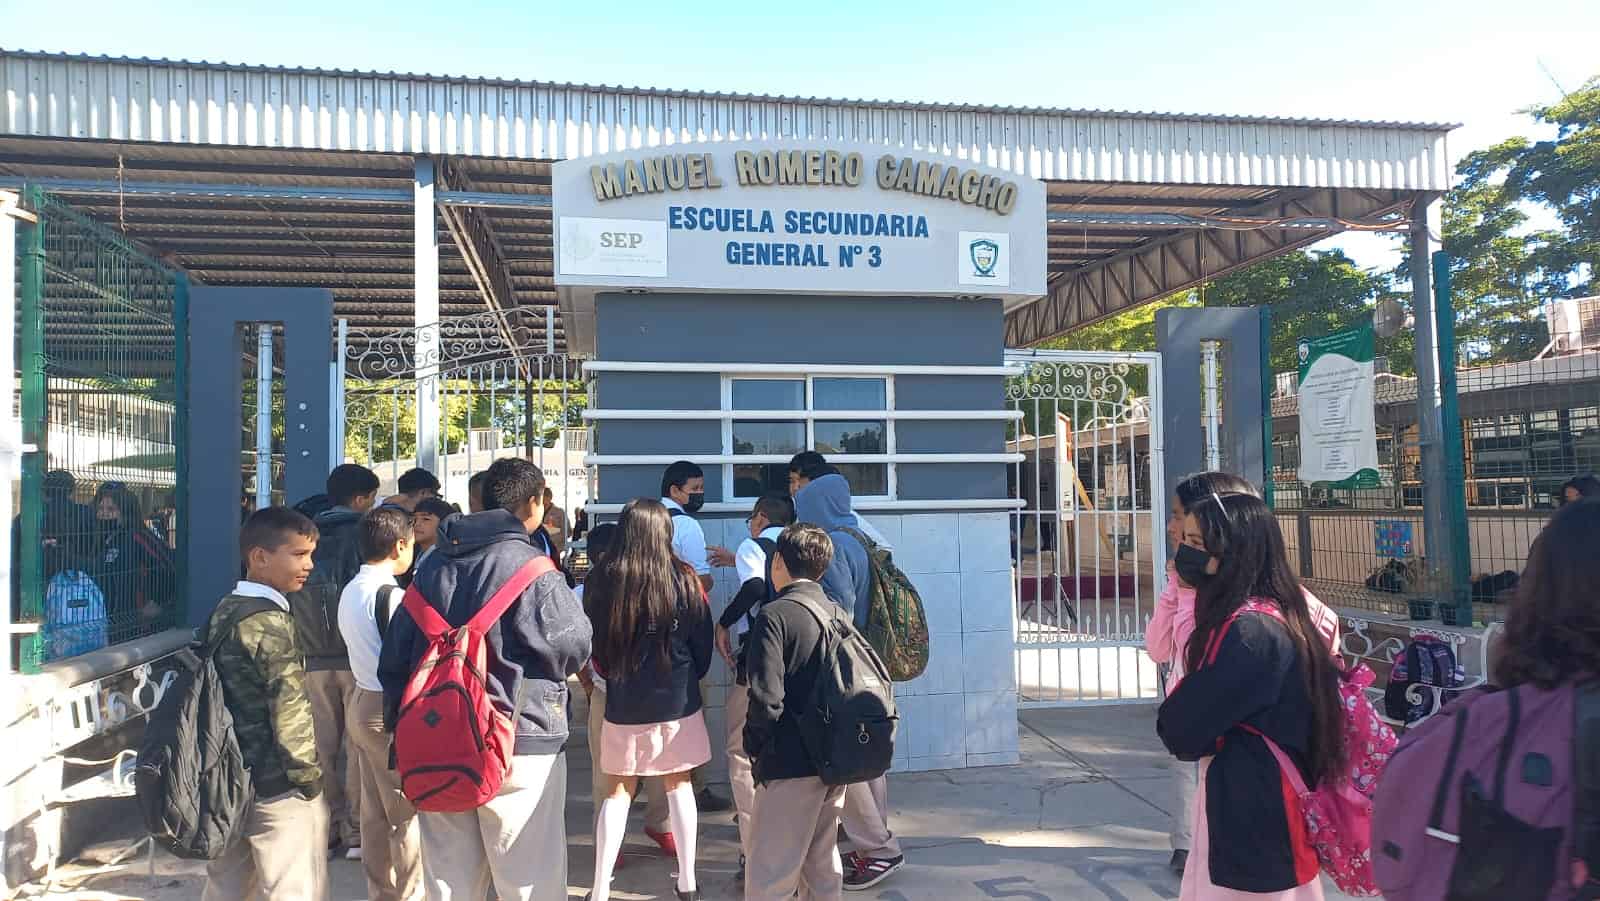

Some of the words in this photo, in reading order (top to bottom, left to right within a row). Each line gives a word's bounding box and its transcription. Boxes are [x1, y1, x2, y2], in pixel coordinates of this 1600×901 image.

[591, 152, 722, 202] MANUEL
[735, 149, 864, 188] ROMERO
[877, 154, 1018, 216] CAMACHO
[669, 206, 774, 233] ESCUELA
[785, 209, 929, 238] SECUNDARIA
[600, 232, 642, 249] SEP
[726, 241, 829, 267] GENERAL
[868, 245, 882, 268] 3
